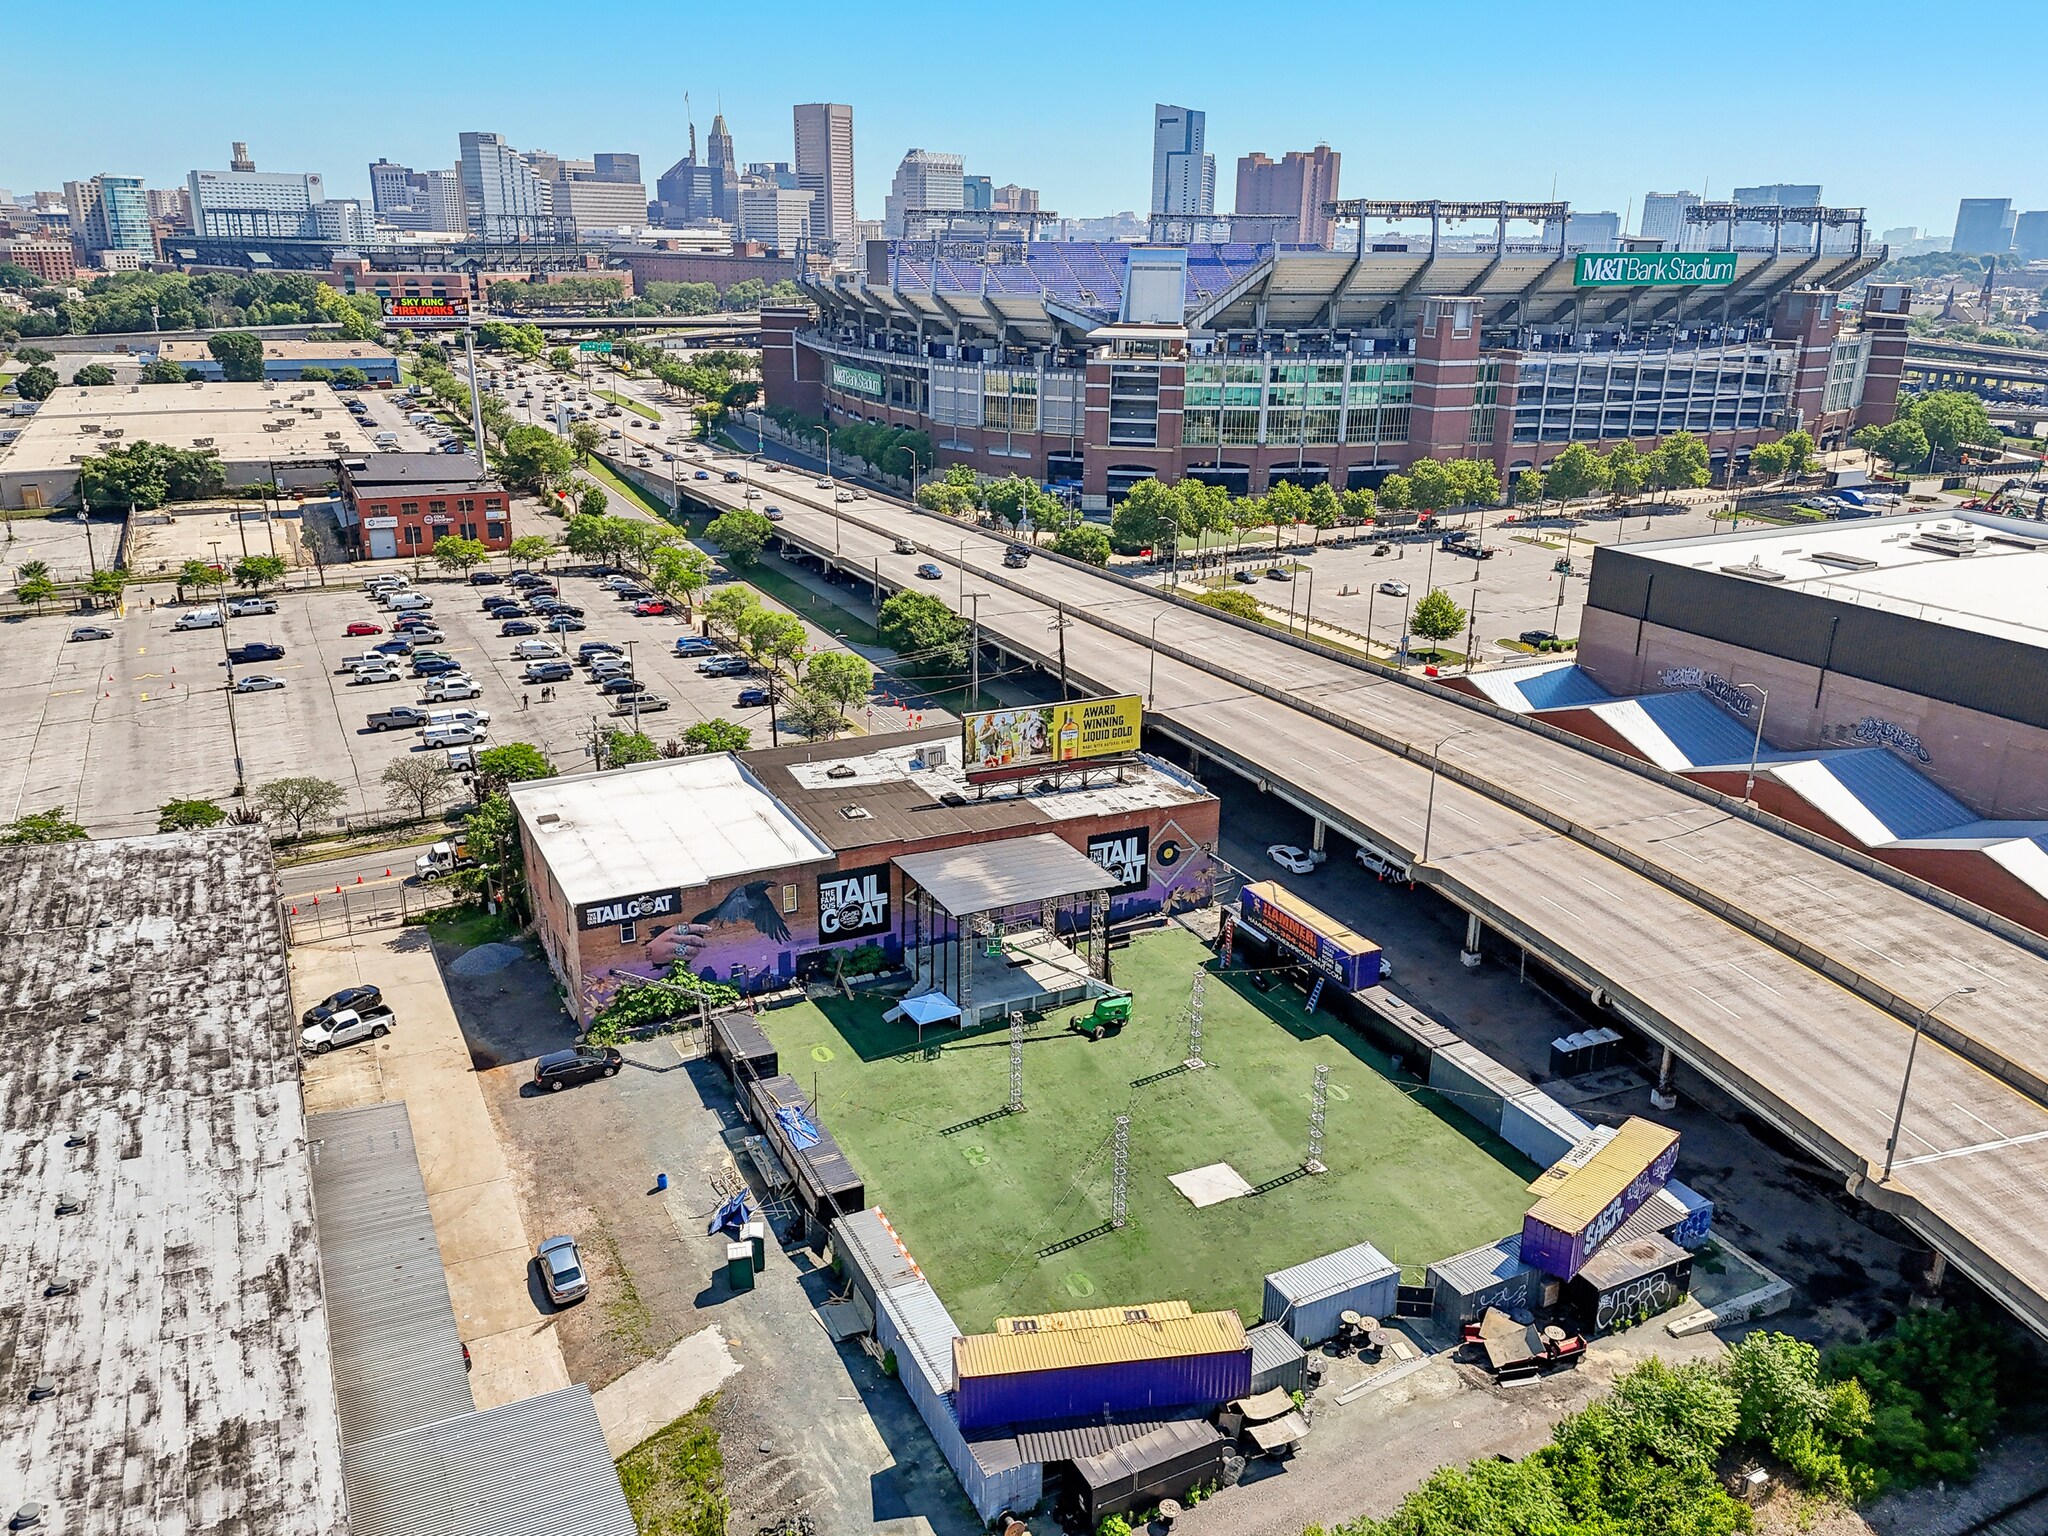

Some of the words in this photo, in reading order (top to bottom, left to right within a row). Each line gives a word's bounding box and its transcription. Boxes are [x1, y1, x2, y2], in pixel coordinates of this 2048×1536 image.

[1582, 257, 1628, 281] M&T
[1627, 257, 1667, 281] Bank
[1668, 257, 1733, 281] Stadium
[401, 298, 419, 306] SKY
[421, 298, 444, 306] KING
[392, 306, 454, 315] FIREWORKS
[1083, 704, 1116, 719] AWARD
[1083, 716, 1124, 730] WINNING
[1082, 729, 1110, 743] LIQUID
[1111, 726, 1133, 739] GOLD
[1090, 836, 1146, 868] TAIL
[820, 874, 888, 908] TAIL
[820, 889, 836, 900] THE
[821, 895, 836, 905] FAM
[821, 903, 836, 911] OUS
